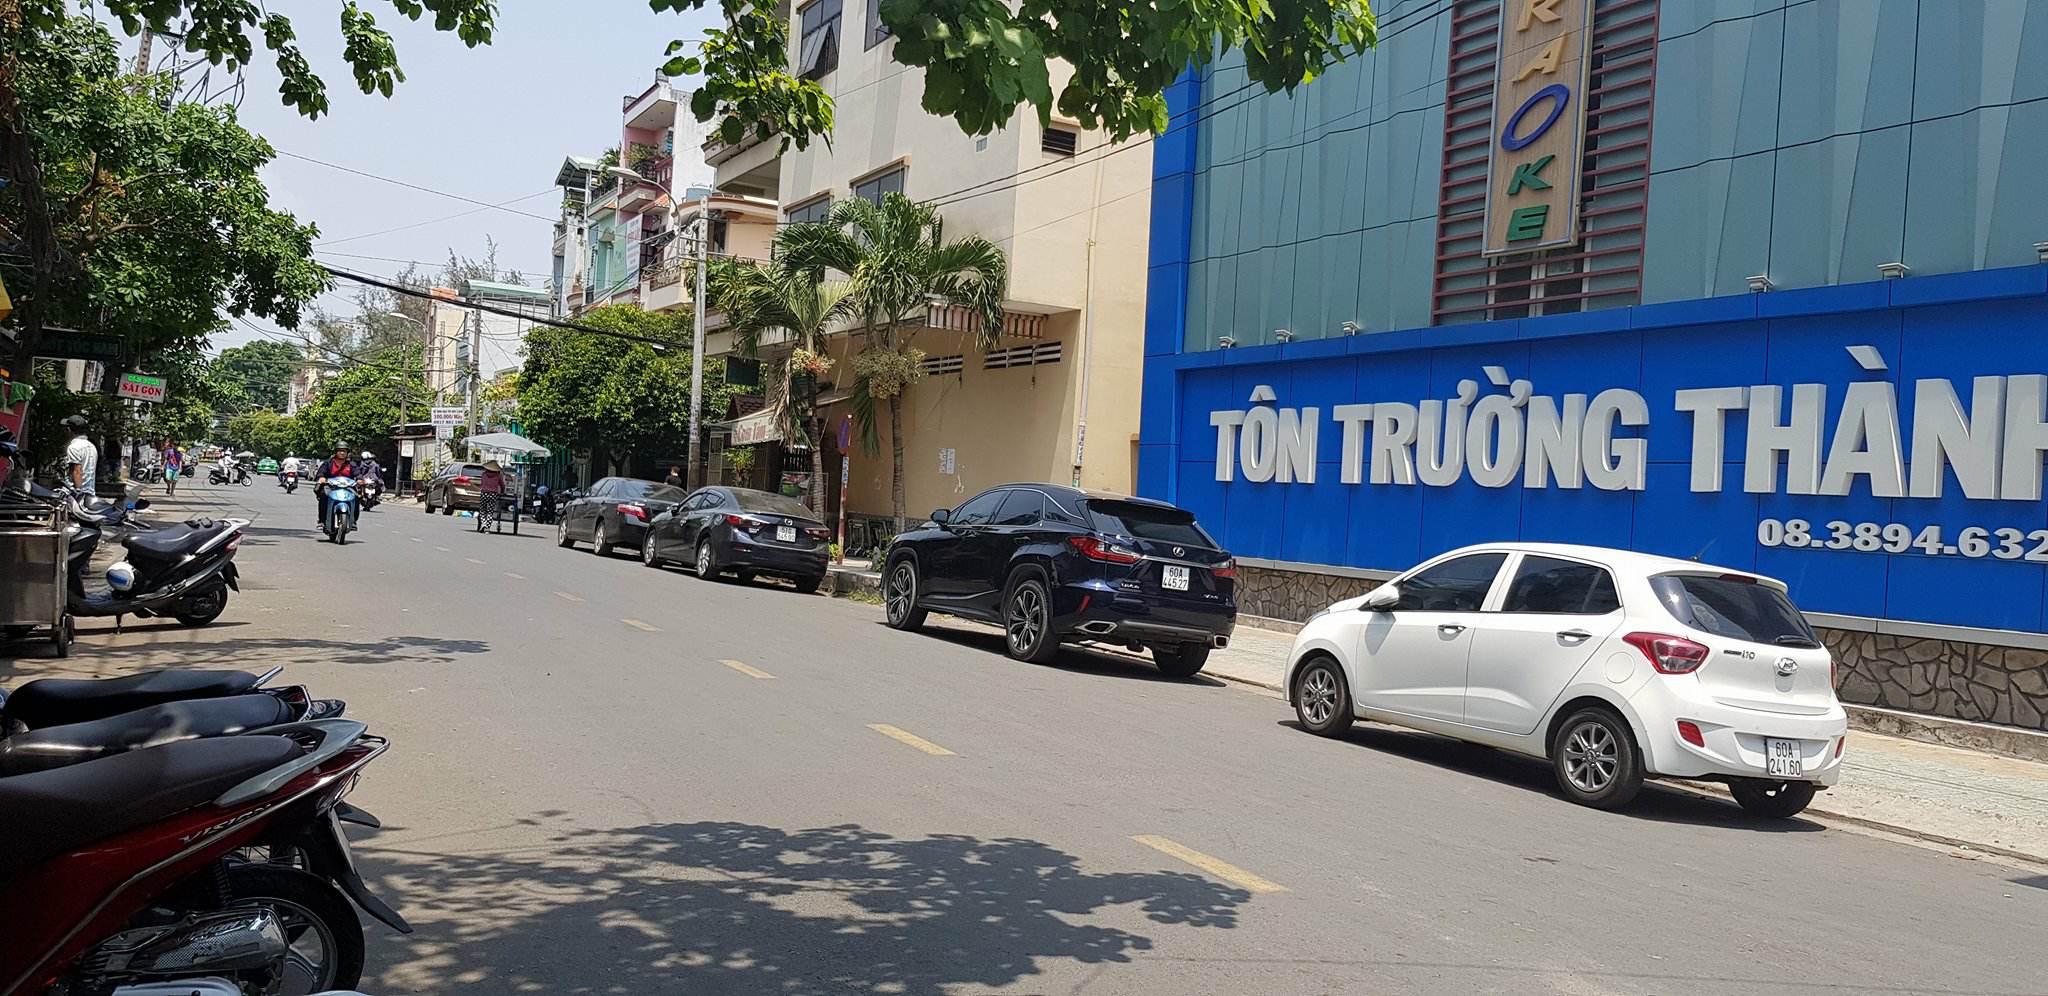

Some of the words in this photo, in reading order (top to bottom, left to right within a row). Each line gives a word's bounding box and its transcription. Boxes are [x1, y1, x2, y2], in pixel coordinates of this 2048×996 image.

[1210, 384, 1320, 485] TÔN
[1333, 365, 1650, 491] TRƯỜNG
[1675, 345, 2048, 501] THÀNH
[1169, 567, 1183, 578] 60A
[1775, 741, 1793, 759] 60A
[1769, 757, 1802, 776] 241.60
